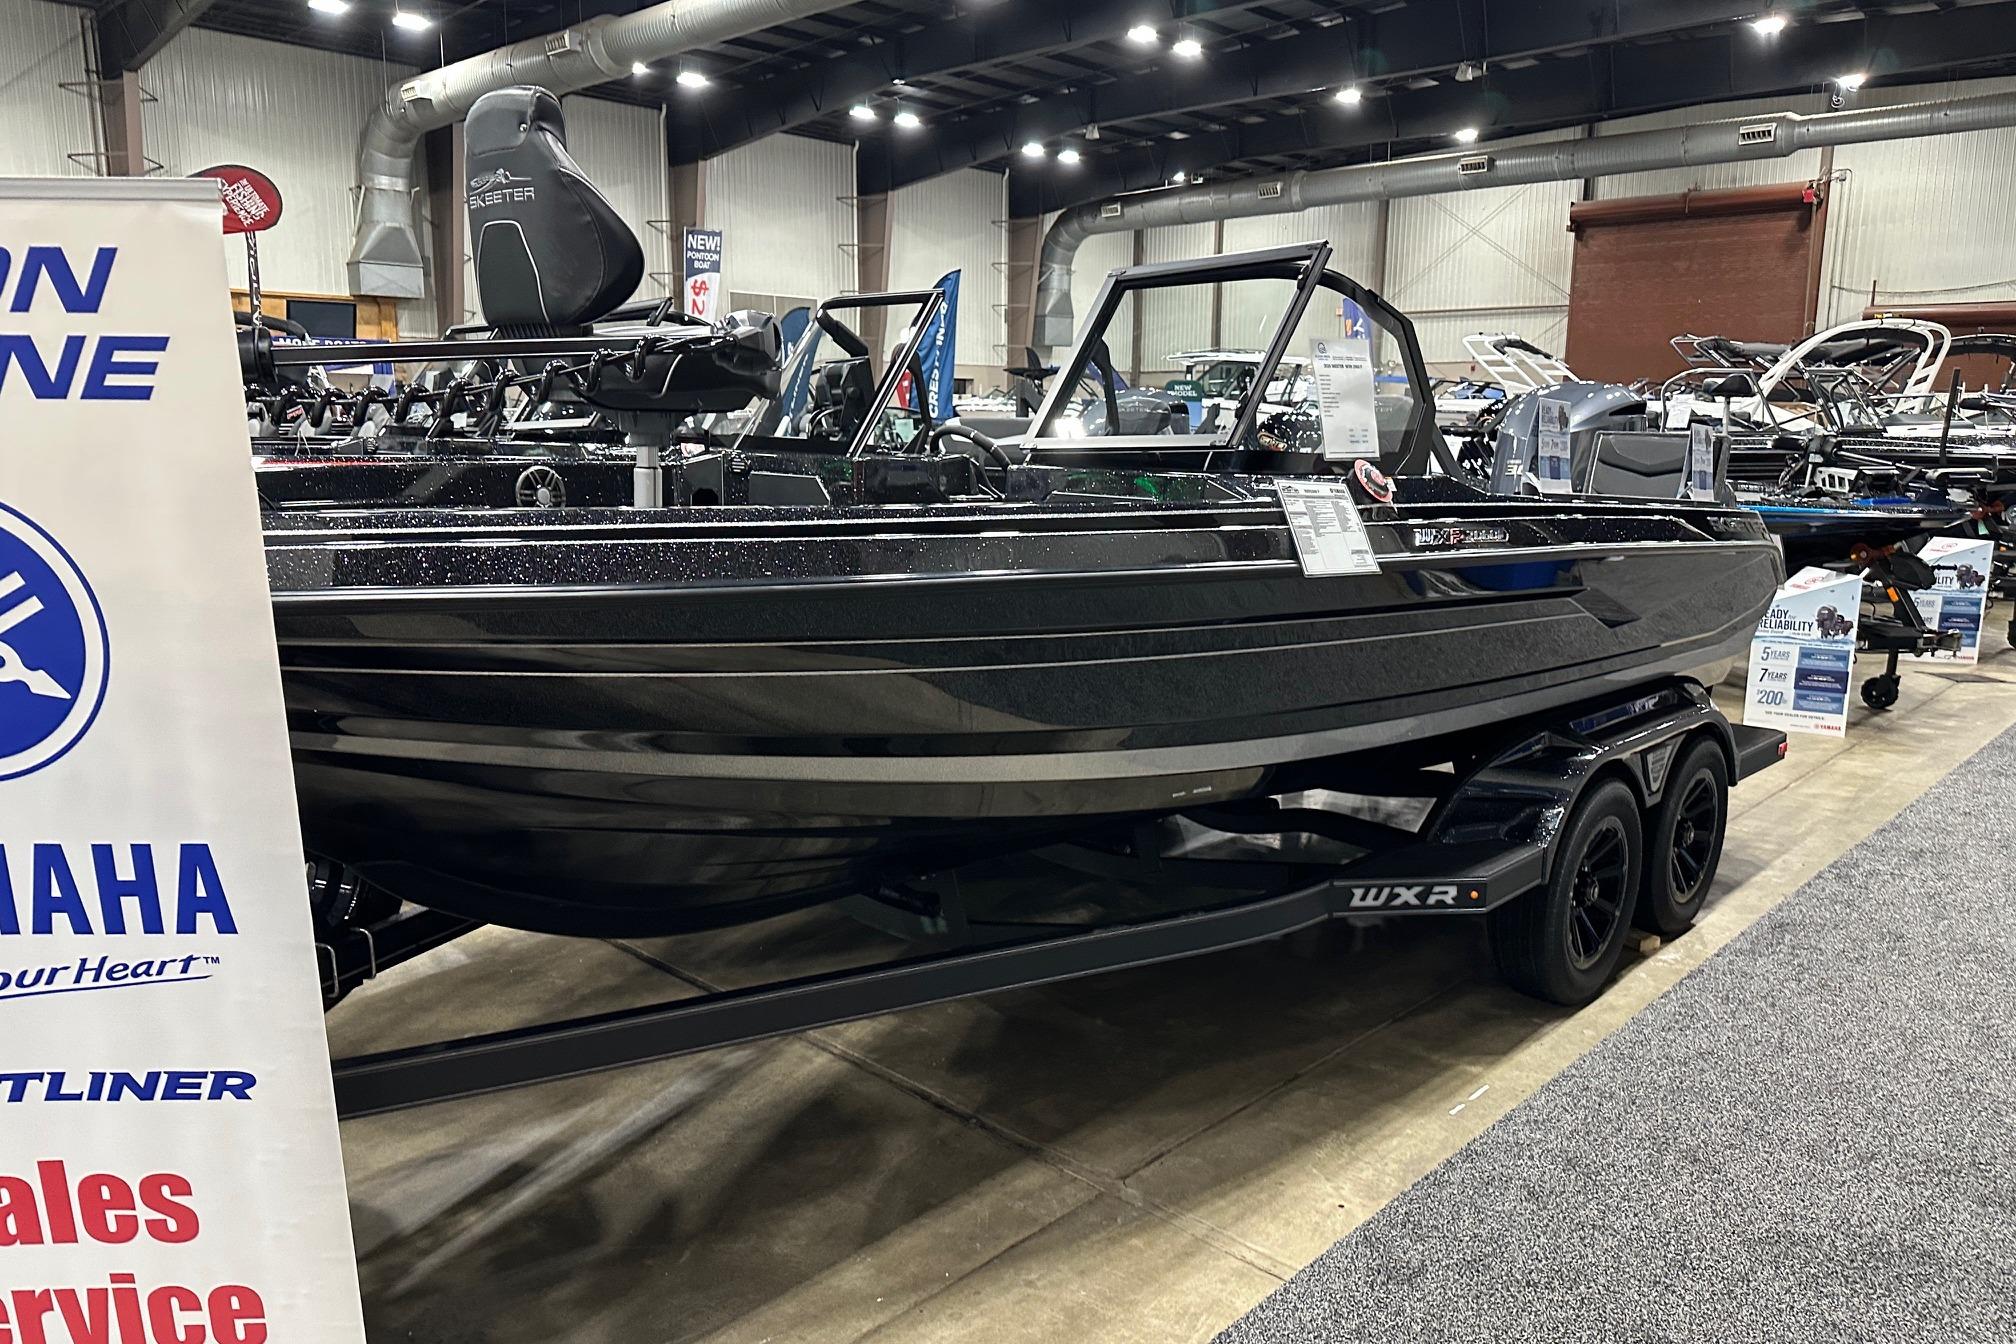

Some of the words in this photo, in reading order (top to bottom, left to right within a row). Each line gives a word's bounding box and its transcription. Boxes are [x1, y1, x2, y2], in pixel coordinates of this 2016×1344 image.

[222, 184, 254, 227] XPERIENCE
[230, 181, 264, 220] FISHING
[469, 187, 535, 210] SKEETER
[687, 234, 720, 251] NEW!
[687, 250, 719, 262] PONTOON
[693, 260, 711, 269] BOAT
[0, 246, 118, 313] N
[928, 301, 948, 419] CRESINR
[1933, 575, 1954, 586] LITY
[1764, 608, 1789, 620] EADY
[1761, 647, 1771, 661] 5
[1770, 650, 1790, 660] YEARS
[1760, 668, 1769, 682] 7
[1767, 672, 1788, 680] YEARS
[1350, 885, 1457, 907] WXR
[73, 954, 201, 984] Heart
[0, 1273, 267, 1344] rvice
